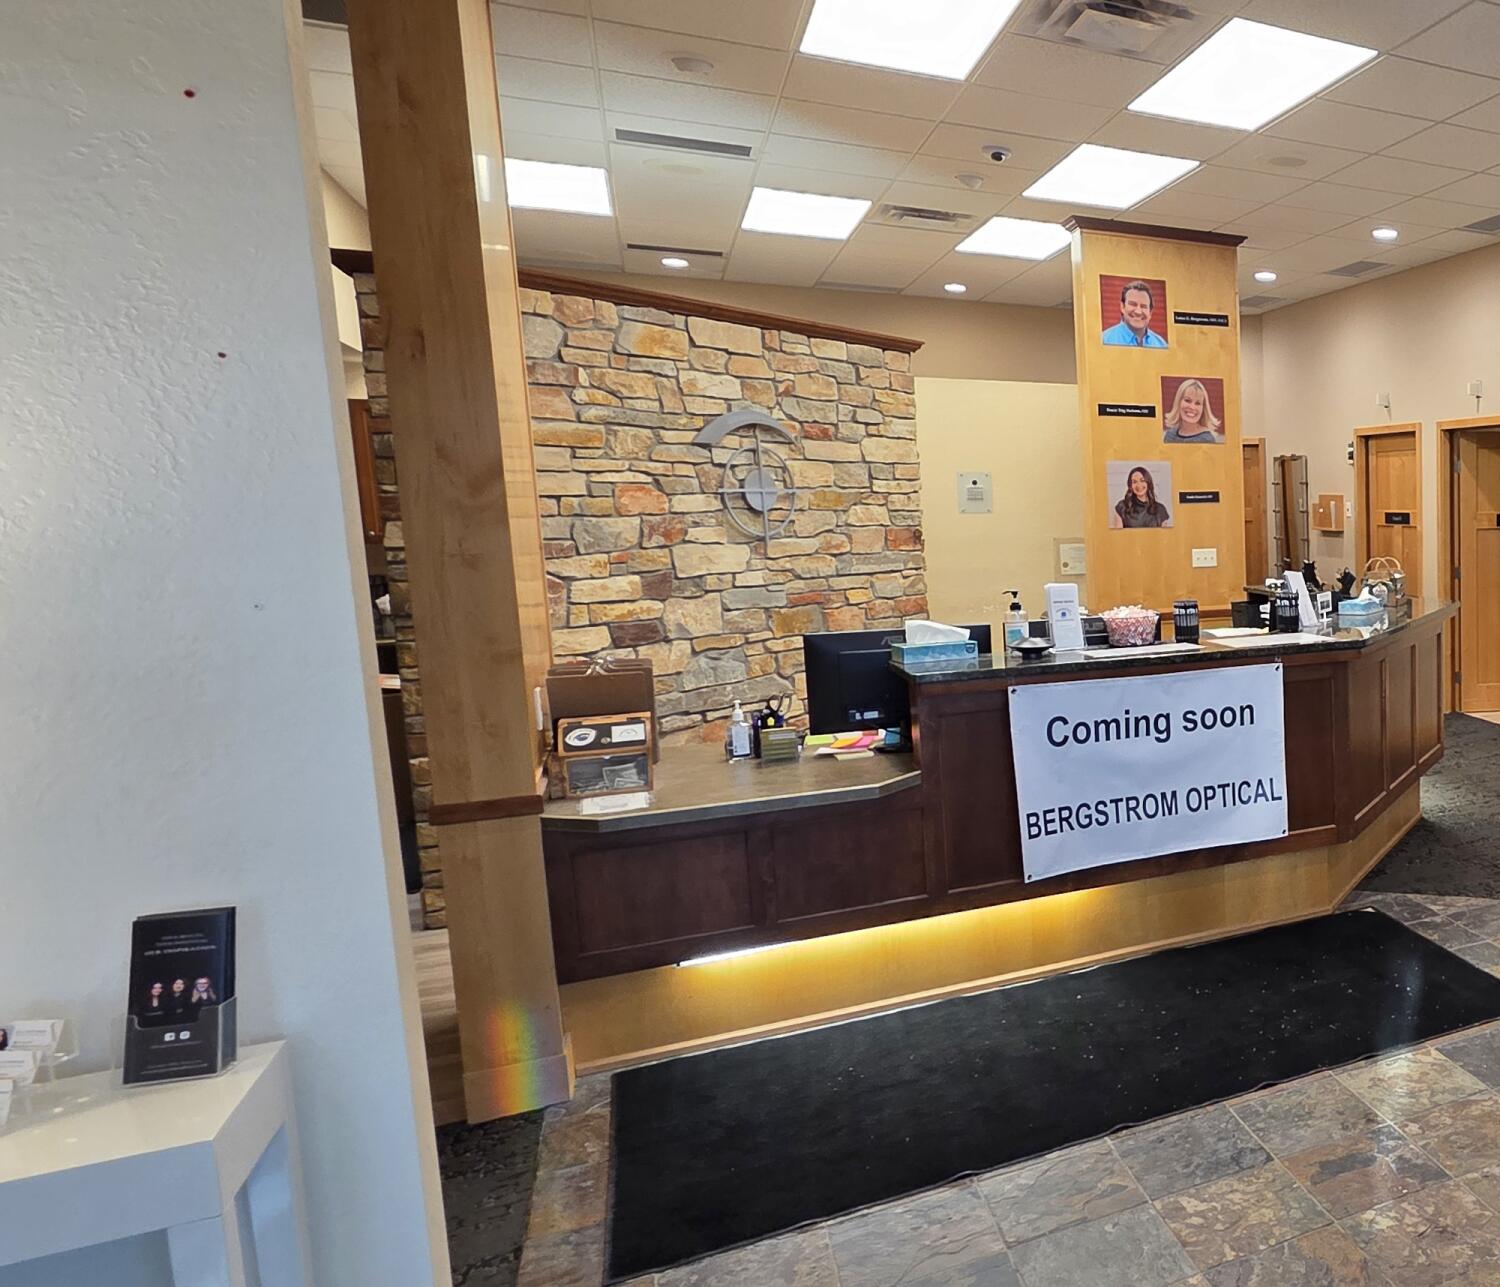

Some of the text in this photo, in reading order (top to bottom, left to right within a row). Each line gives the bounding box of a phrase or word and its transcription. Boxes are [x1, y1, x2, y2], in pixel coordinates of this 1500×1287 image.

[1046, 703, 1255, 748] Coming soon
[1026, 777, 1283, 840] BERGSTROM OPTICAL
